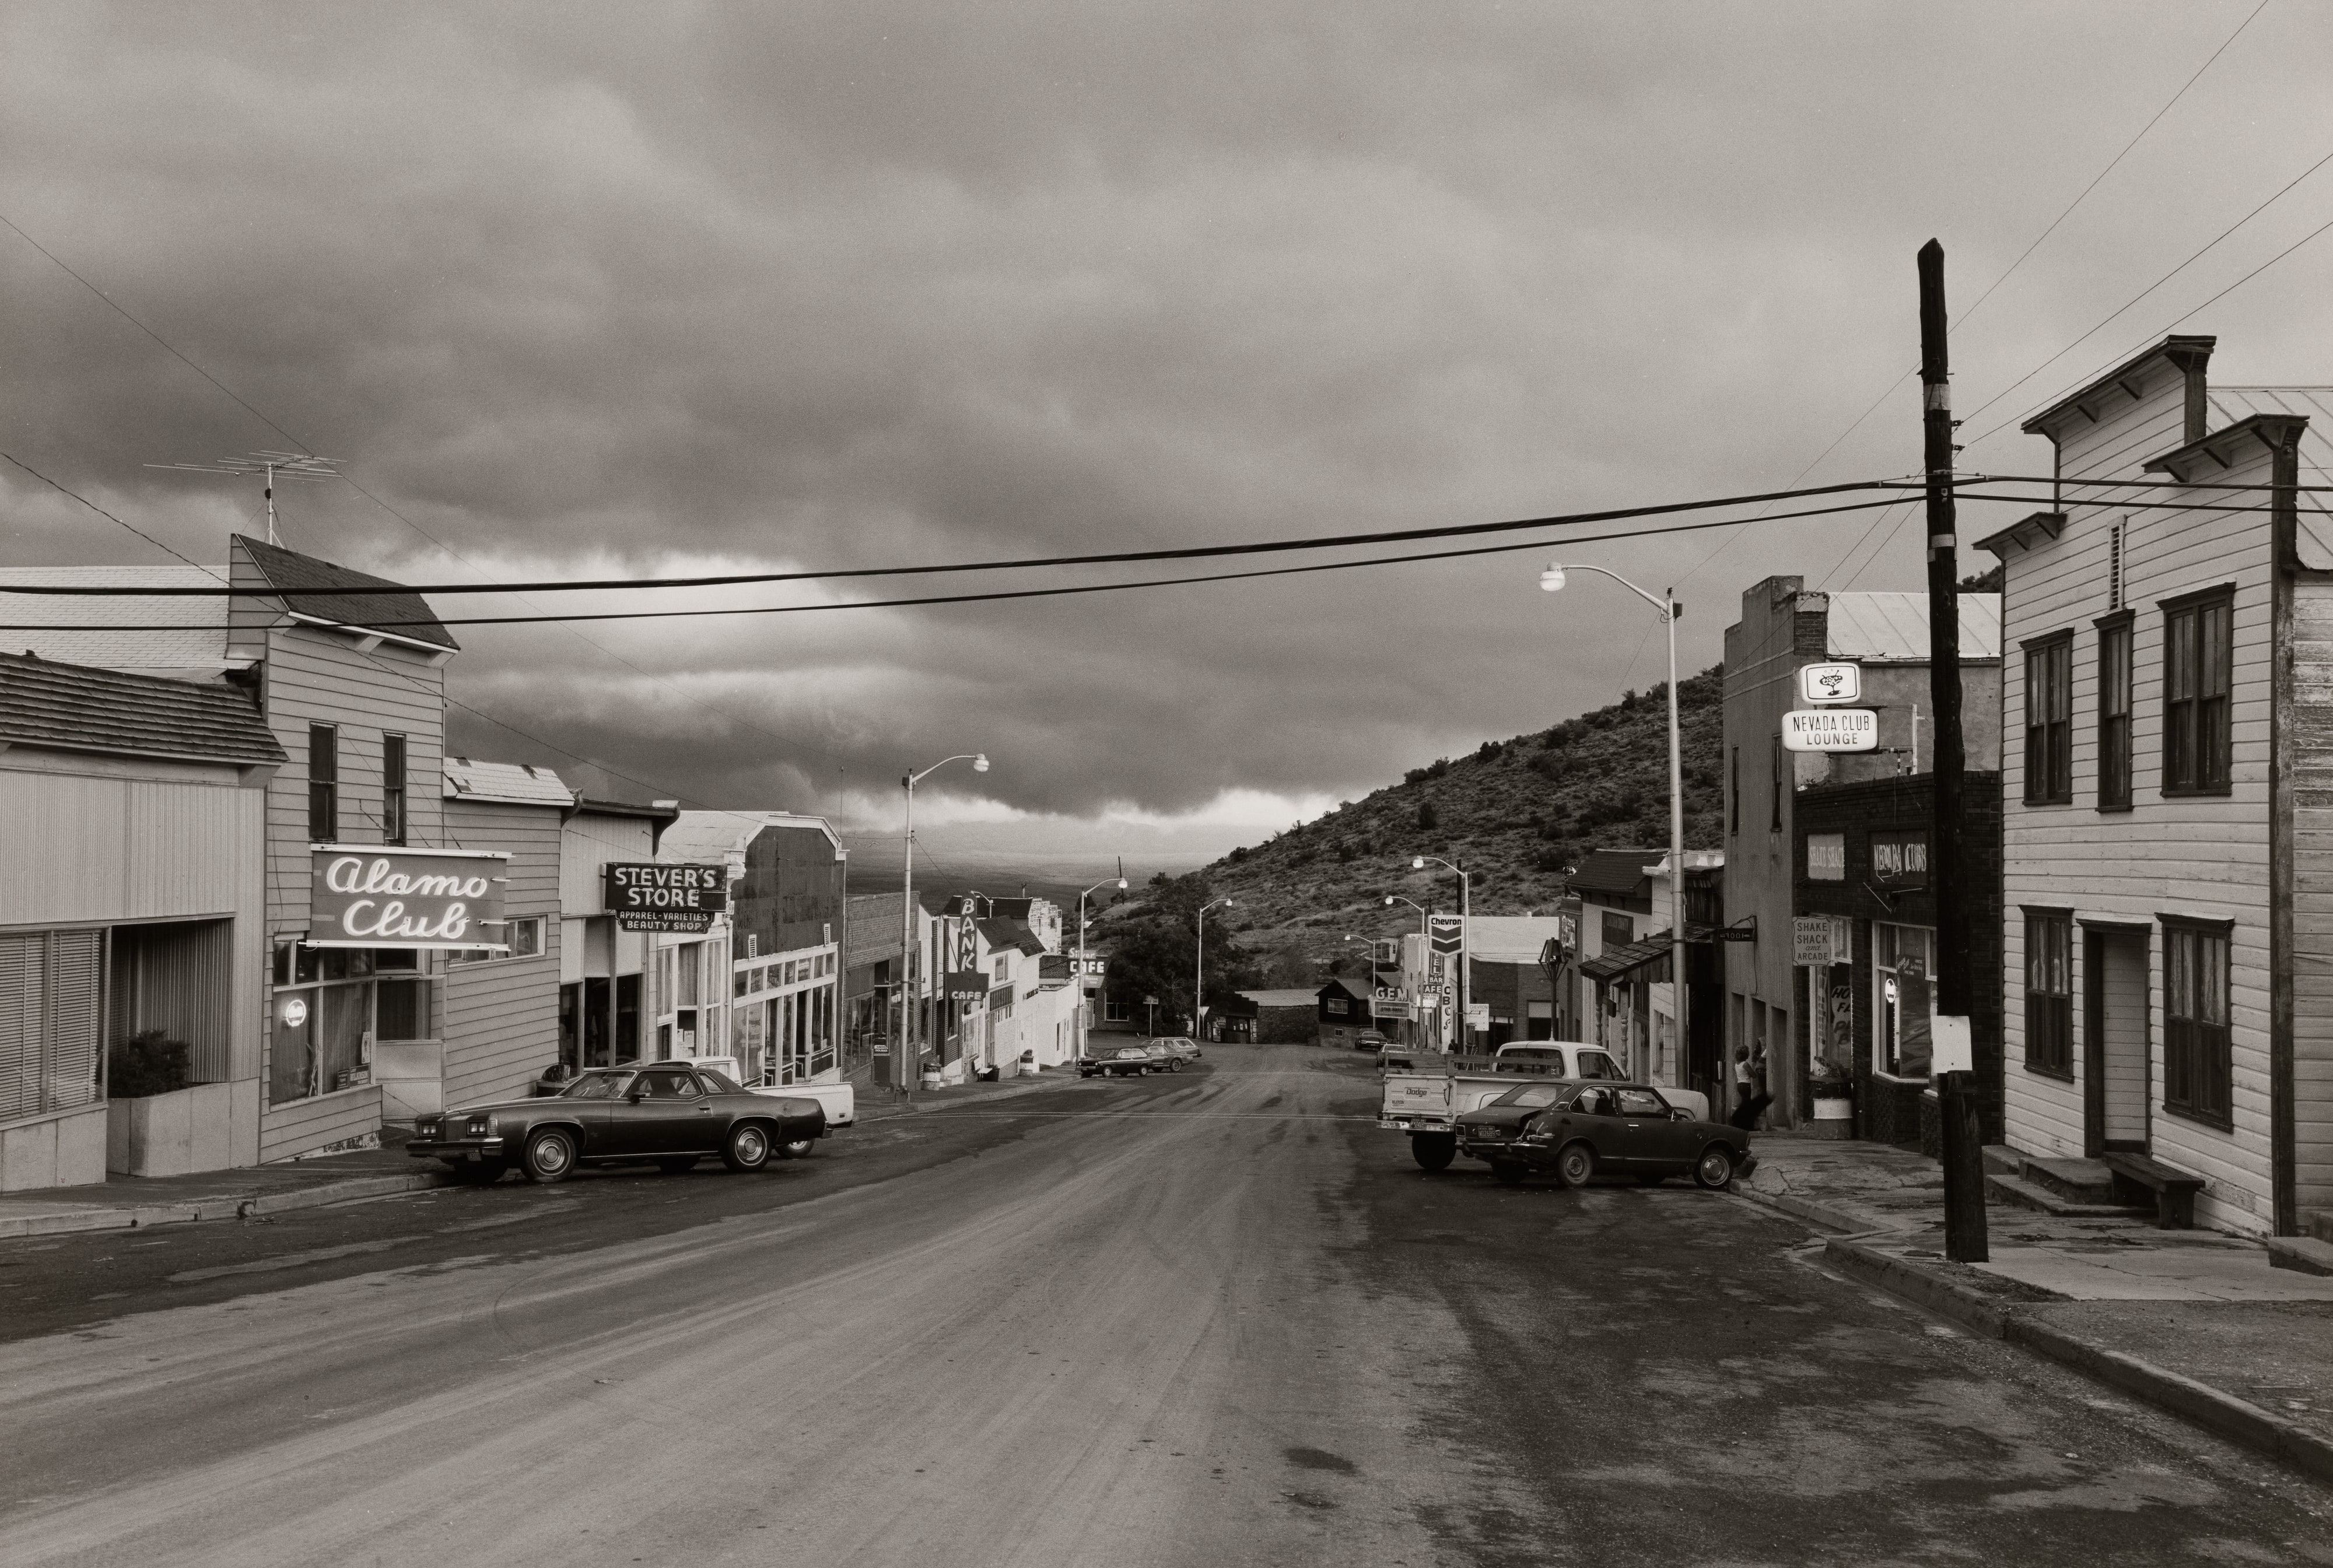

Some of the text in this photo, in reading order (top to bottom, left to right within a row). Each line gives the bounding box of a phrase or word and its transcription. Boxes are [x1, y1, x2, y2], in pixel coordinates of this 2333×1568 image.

[1793, 715, 1869, 732] NEVADA CLUB
[1807, 732, 1858, 745] LOUNGE
[325, 857, 488, 898] Alamo
[615, 867, 716, 888] STEVER'S
[628, 888, 700, 907] STORE
[343, 899, 470, 939] Club
[627, 921, 702, 931] BEAUTY SHOP
[1797, 922, 1828, 932] SHAKE
[961, 898, 975, 971] BANK
[1797, 935, 1828, 944] SHACK
[1797, 952, 1828, 960] ARCADE
[952, 991, 982, 1000] CAFE
[1375, 987, 1409, 1001] GEM
[1406, 1088, 1427, 1097] Dodge
